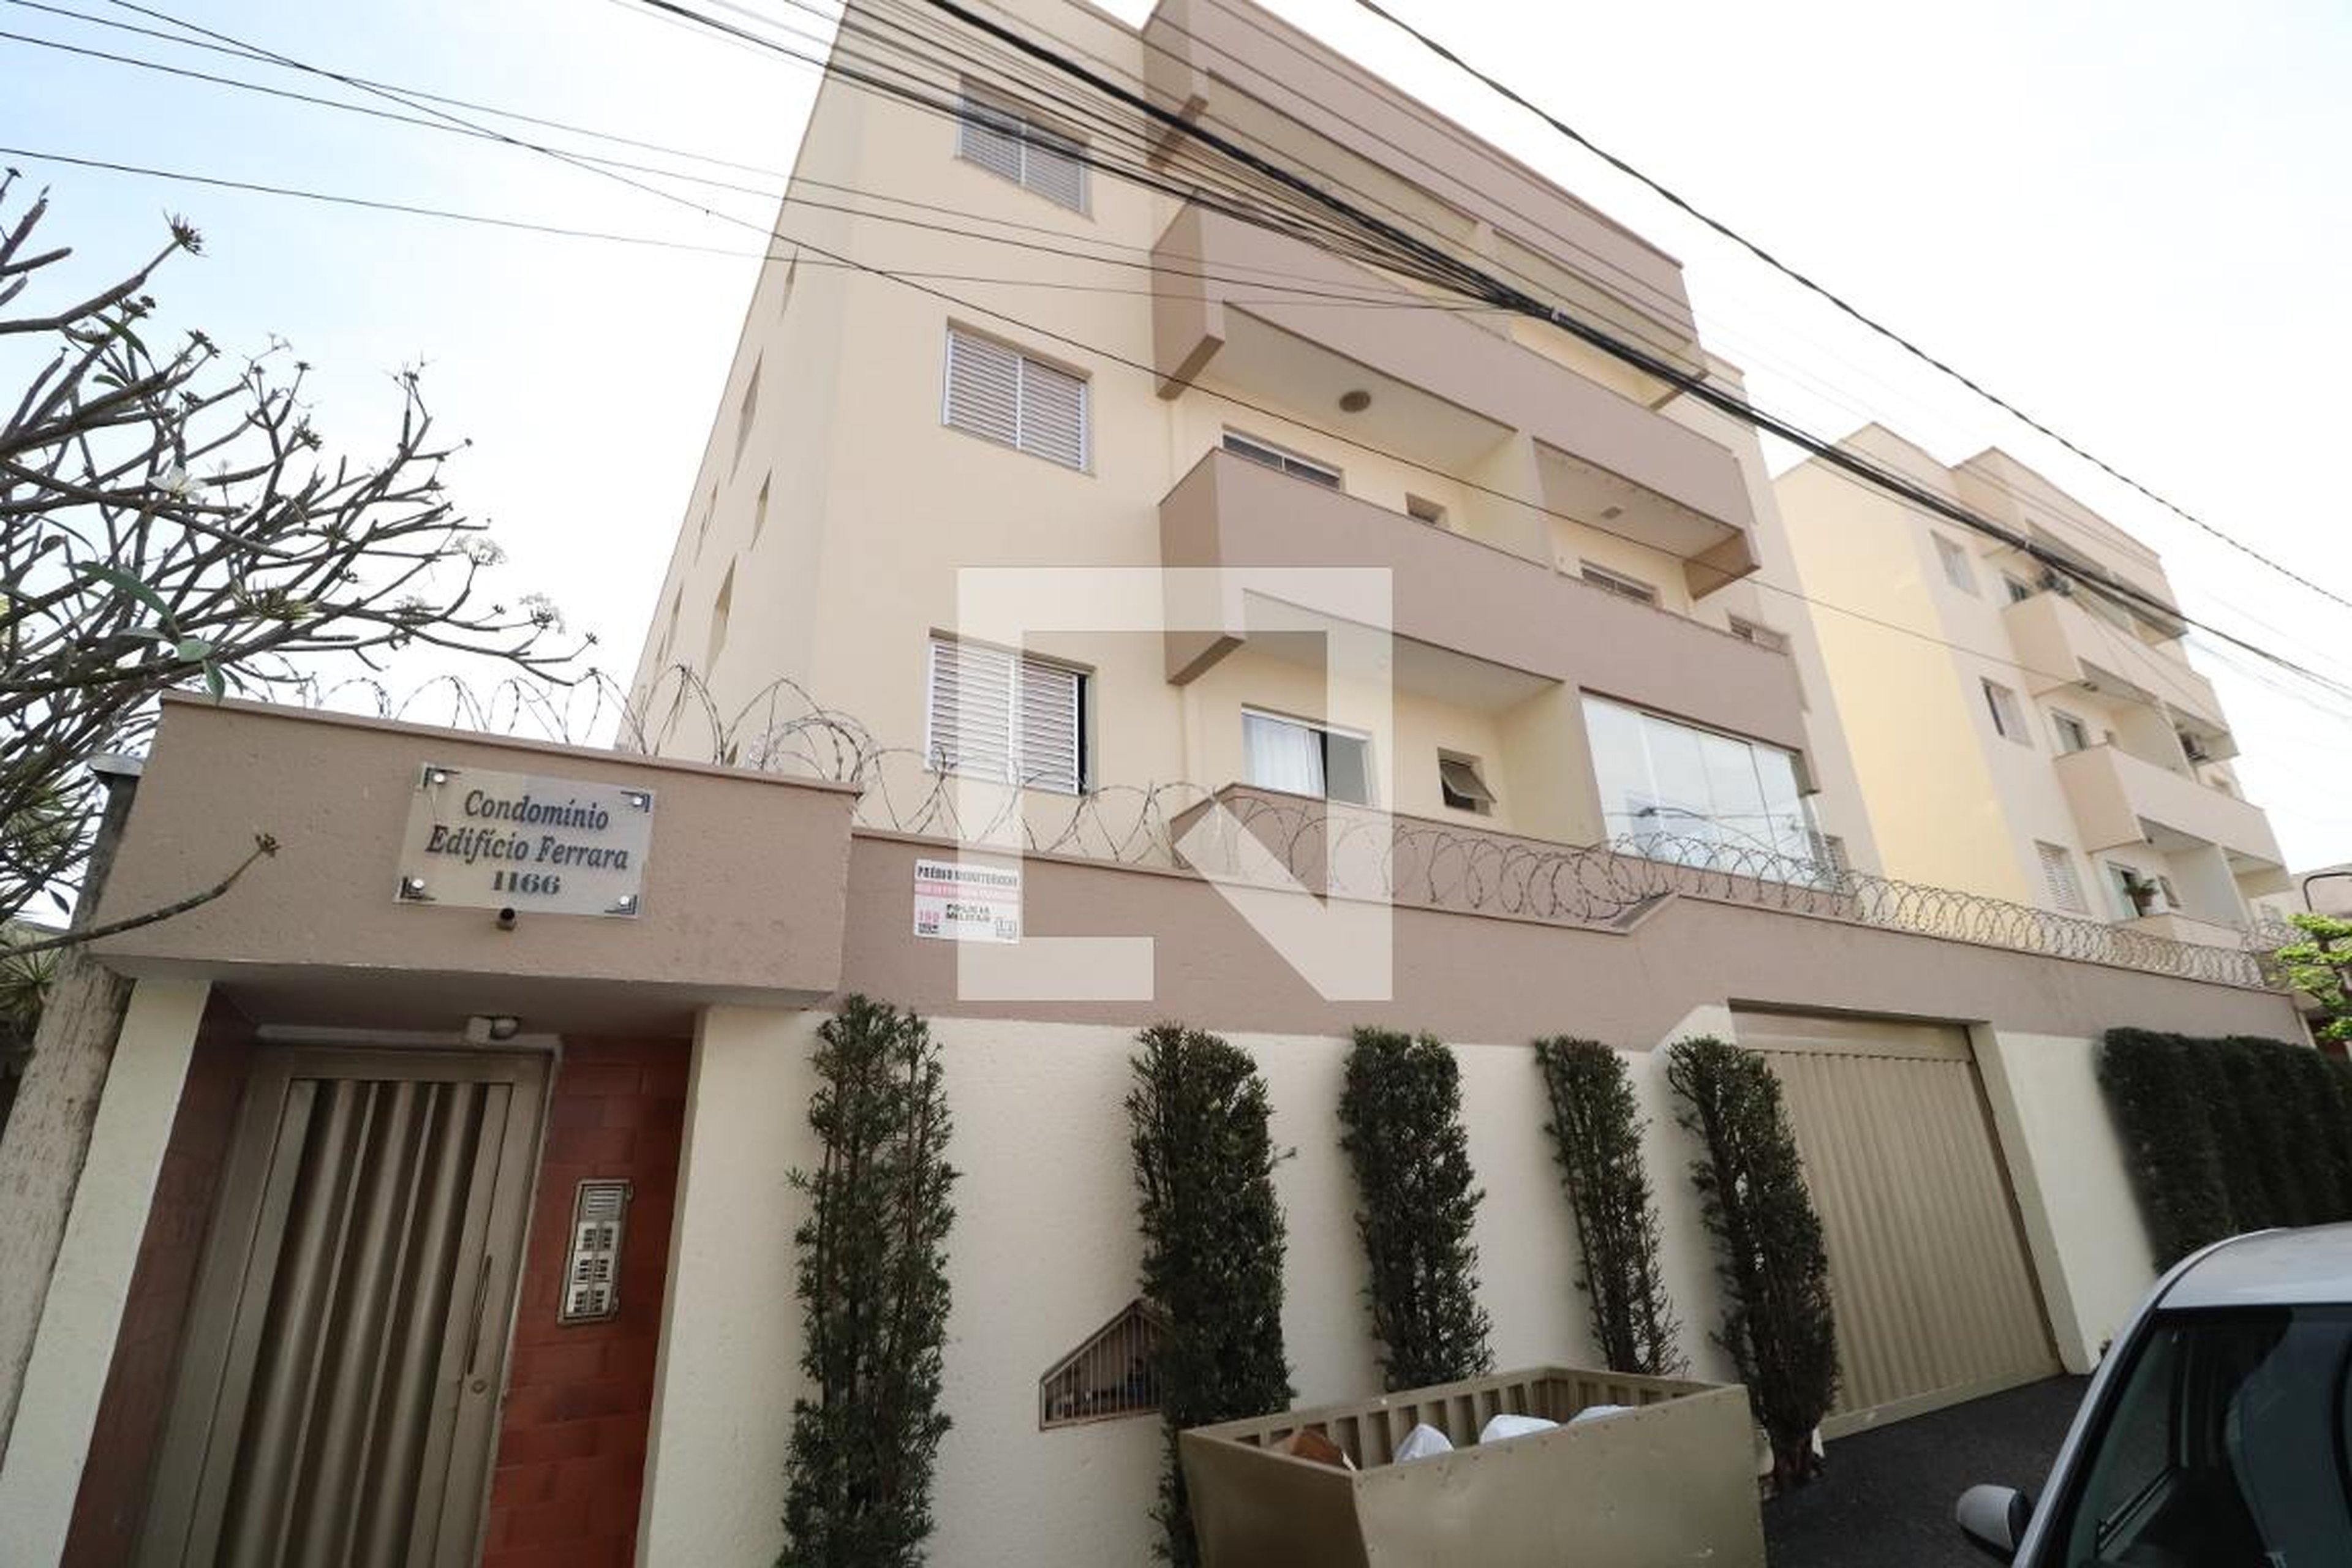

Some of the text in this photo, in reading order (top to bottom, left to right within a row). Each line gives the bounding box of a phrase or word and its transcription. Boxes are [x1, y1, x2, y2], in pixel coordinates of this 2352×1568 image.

[464, 790, 609, 831] Condomínio
[426, 825, 628, 870] Edifício Ferrara
[492, 870, 560, 895] 1166
